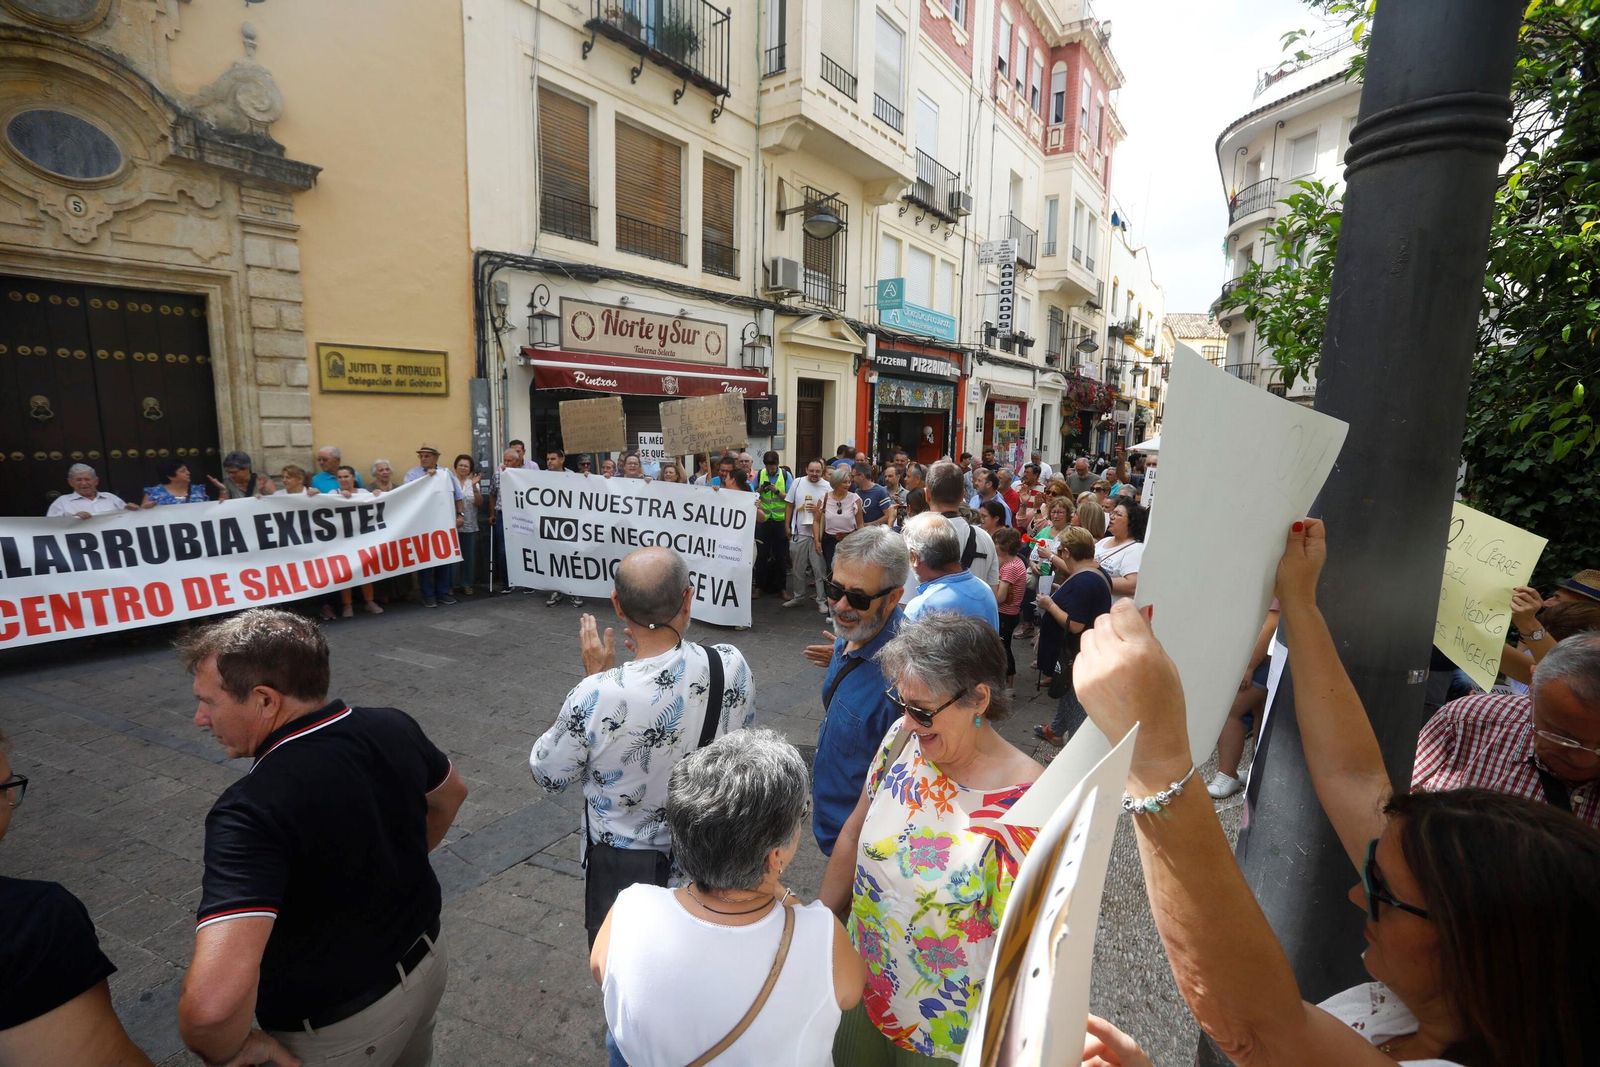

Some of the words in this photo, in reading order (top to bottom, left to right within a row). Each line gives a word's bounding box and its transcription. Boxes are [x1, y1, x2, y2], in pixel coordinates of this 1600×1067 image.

[999, 263, 1013, 328] ABOGADOS
[601, 308, 654, 341] Norte
[658, 324, 668, 348] y
[670, 319, 700, 345] Sur
[634, 344, 656, 355] Taberna
[657, 348, 676, 357] Selecta
[876, 355, 907, 367] PIZZERIA
[348, 362, 378, 374] JUNTA
[381, 364, 392, 375] DE
[348, 376, 392, 387] Delegación
[573, 371, 618, 387] Pintxos
[639, 436, 648, 445] EL
[649, 435, 664, 445] MÉD
[641, 449, 650, 458] SE
[651, 449, 665, 459] QUE
[688, 435, 734, 452] CENTRO
[514, 487, 573, 509] ¡¡CON
[579, 491, 677, 520] NUESTRA
[682, 502, 747, 530] SALUD
[0, 517, 249, 580] LARRUBIA
[254, 502, 387, 550] EXISTE!
[543, 519, 577, 540] NO
[582, 523, 605, 543] SE
[611, 526, 716, 559] NEGOCIA!!
[1476, 538, 1521, 577] CIERRE
[0, 581, 175, 642] CENTRO
[181, 572, 235, 611] DE
[239, 554, 353, 602] SALUD
[357, 528, 461, 577] NUEVO!
[522, 547, 545, 575] EL
[549, 551, 622, 582] MÉDIC
[711, 576, 739, 608] VA
